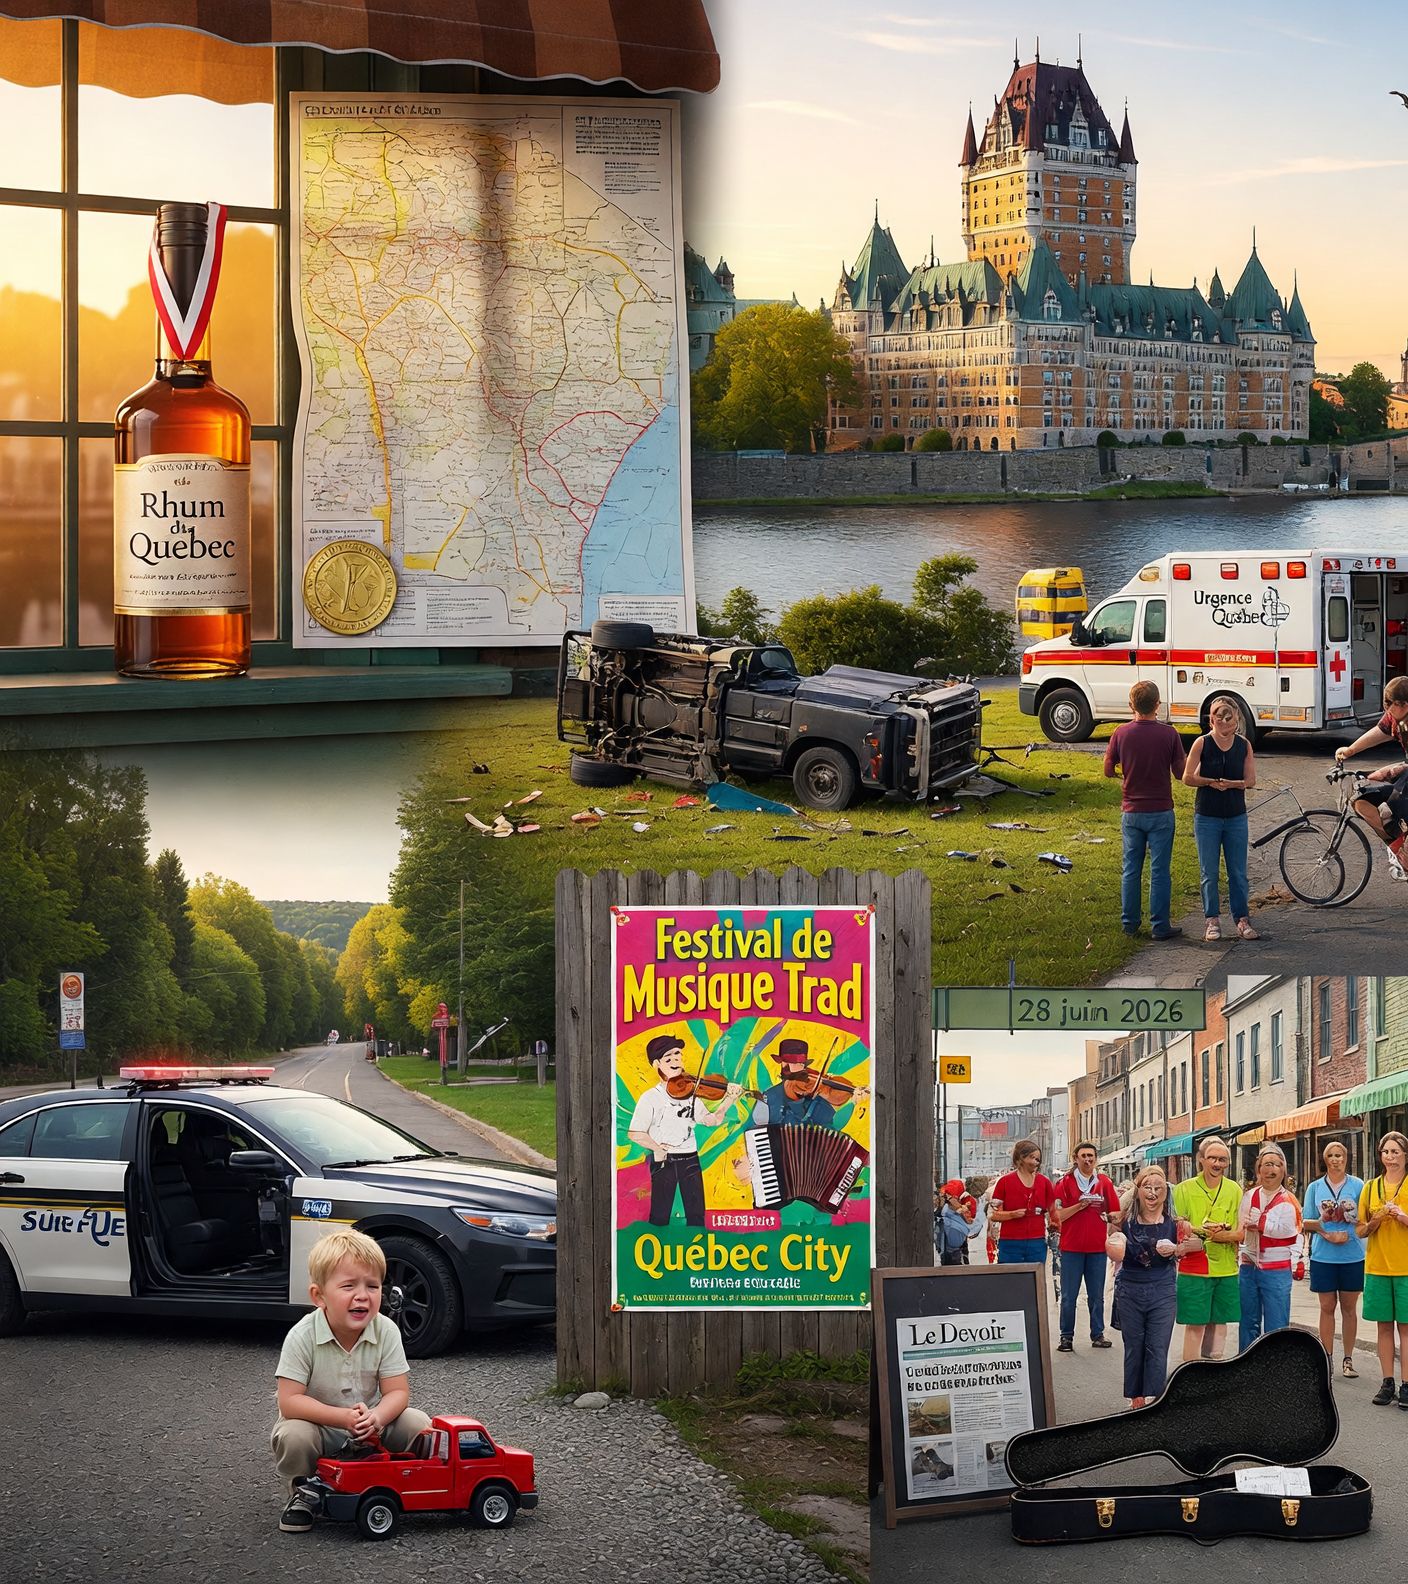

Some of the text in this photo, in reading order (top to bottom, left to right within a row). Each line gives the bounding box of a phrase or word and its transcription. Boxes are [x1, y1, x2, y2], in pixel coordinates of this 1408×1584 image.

[140, 491, 225, 518] Rhum
[1194, 590, 1252, 608] Urgence
[656, 917, 833, 960] Festival de
[623, 963, 863, 1024] Musique Trad
[1018, 998, 1183, 1026] 28 juin 2026
[634, 1233, 851, 1282] Québec City
[908, 1319, 1006, 1346] Le Devoir
